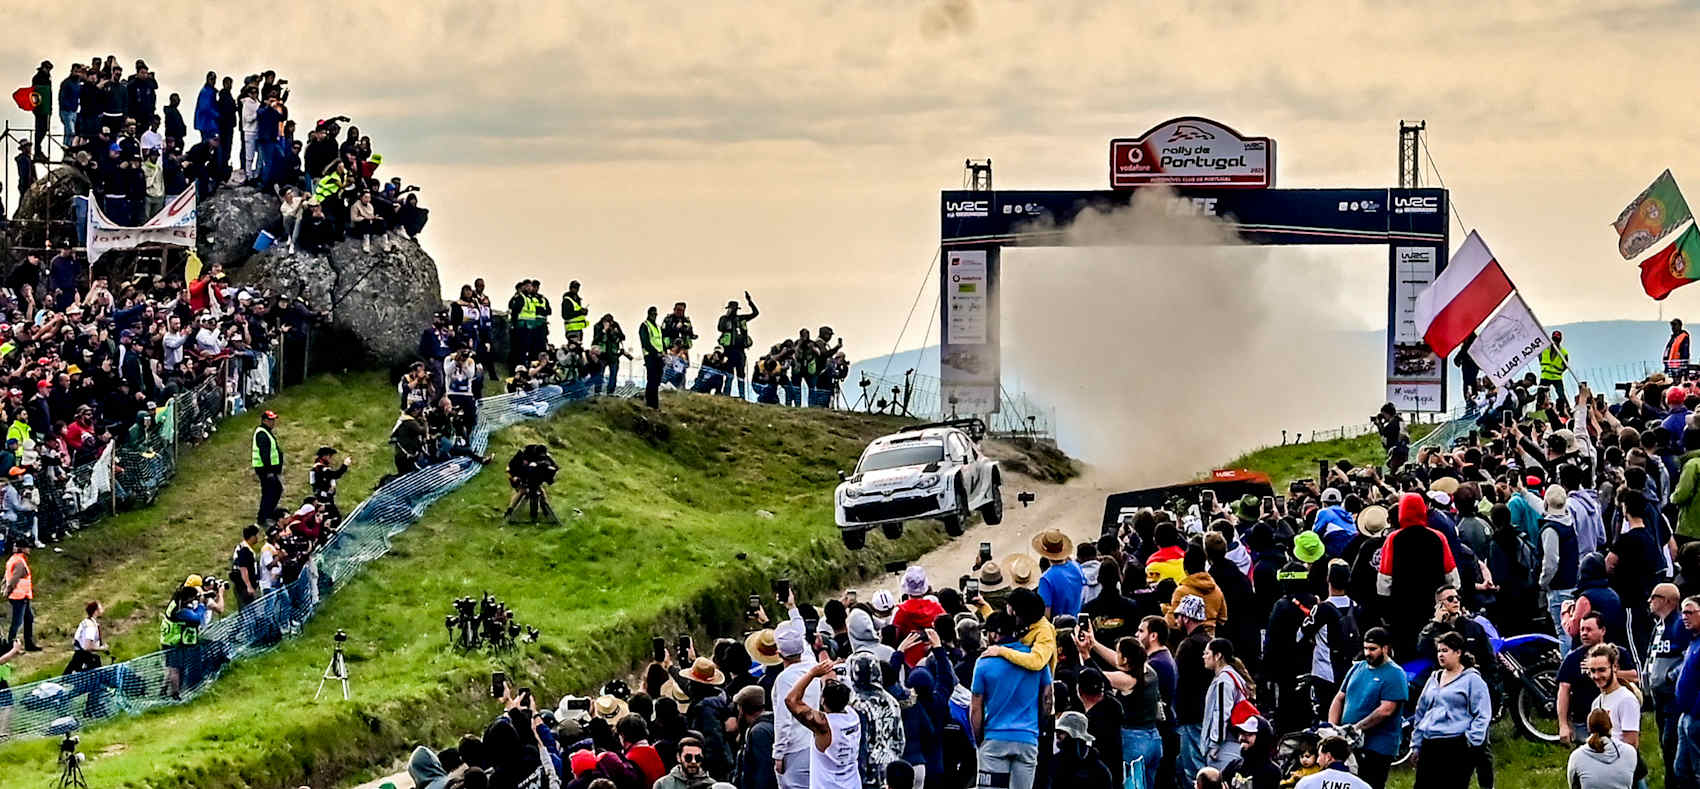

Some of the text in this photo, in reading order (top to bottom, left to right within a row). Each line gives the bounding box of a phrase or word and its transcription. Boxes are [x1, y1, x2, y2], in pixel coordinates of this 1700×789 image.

[1162, 146, 1210, 156] rally de
[1160, 156, 1247, 170] Portugal
[1120, 164, 1151, 172] vodafone
[946, 200, 988, 211] WRC
[1394, 197, 1438, 206] WRC
[1402, 252, 1430, 260] WRC
[1322, 780, 1350, 789] KING
